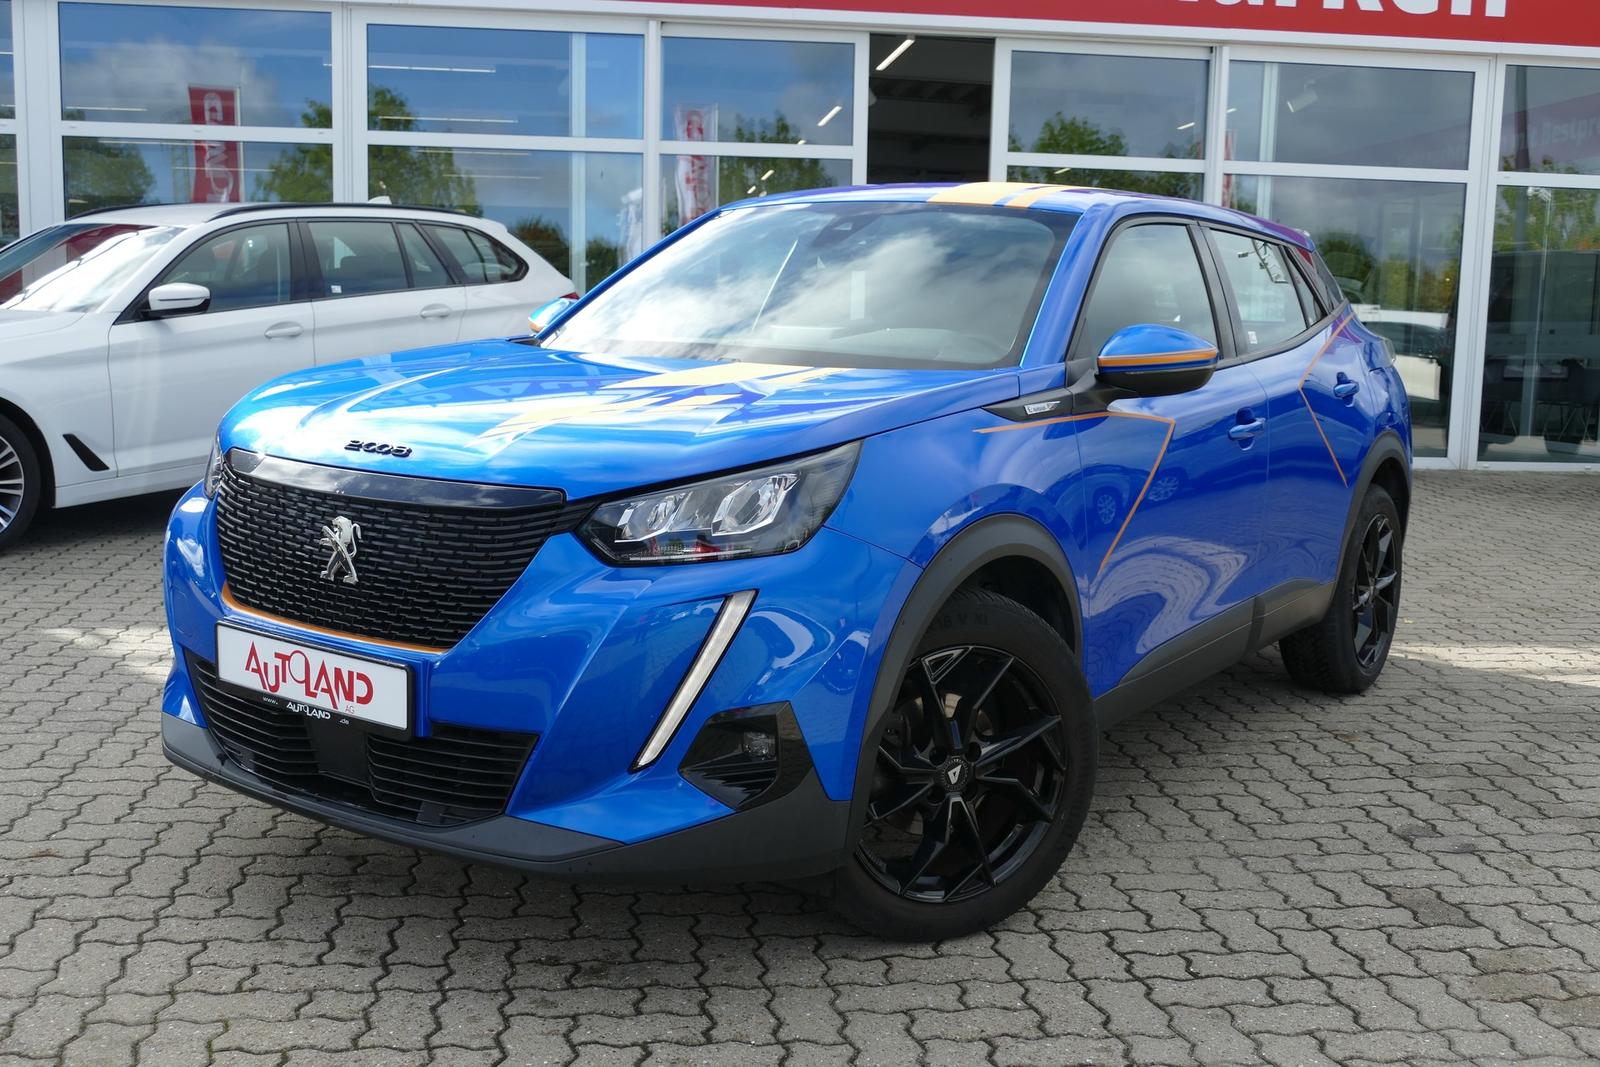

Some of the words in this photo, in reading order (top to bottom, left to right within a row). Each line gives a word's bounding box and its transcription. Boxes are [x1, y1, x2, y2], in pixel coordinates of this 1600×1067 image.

[344, 439, 412, 458] 2008
[245, 641, 374, 711] AUTOLAND
[286, 702, 331, 720] AUTOLAND
